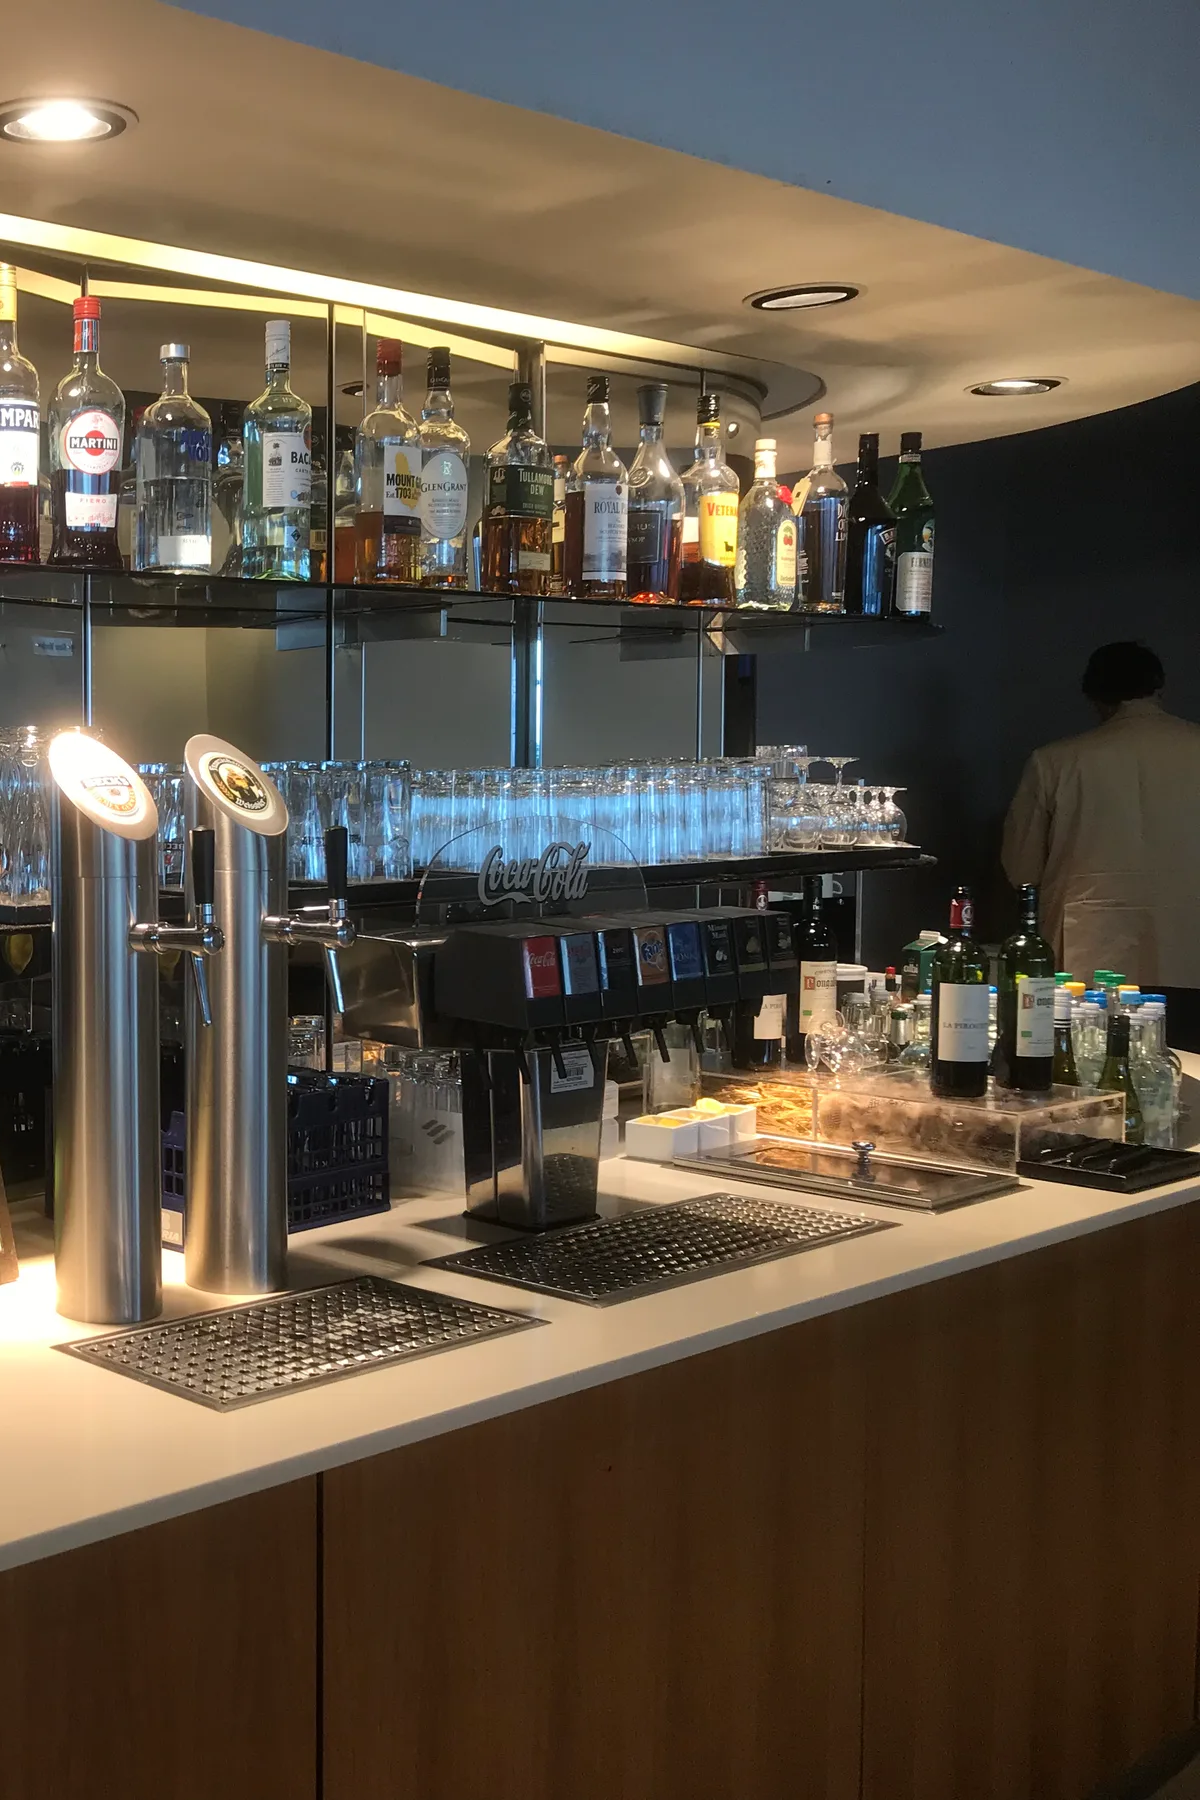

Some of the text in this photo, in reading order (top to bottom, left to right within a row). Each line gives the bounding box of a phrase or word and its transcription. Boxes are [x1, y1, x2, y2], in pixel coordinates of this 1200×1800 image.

[71, 437, 117, 450] MARTINI
[386, 473, 415, 488] MOUNT
[395, 488, 412, 499] 1703
[530, 484, 545, 496] DEW
[594, 501, 620, 514] ROYAL
[478, 841, 592, 906] Coca-Cola
